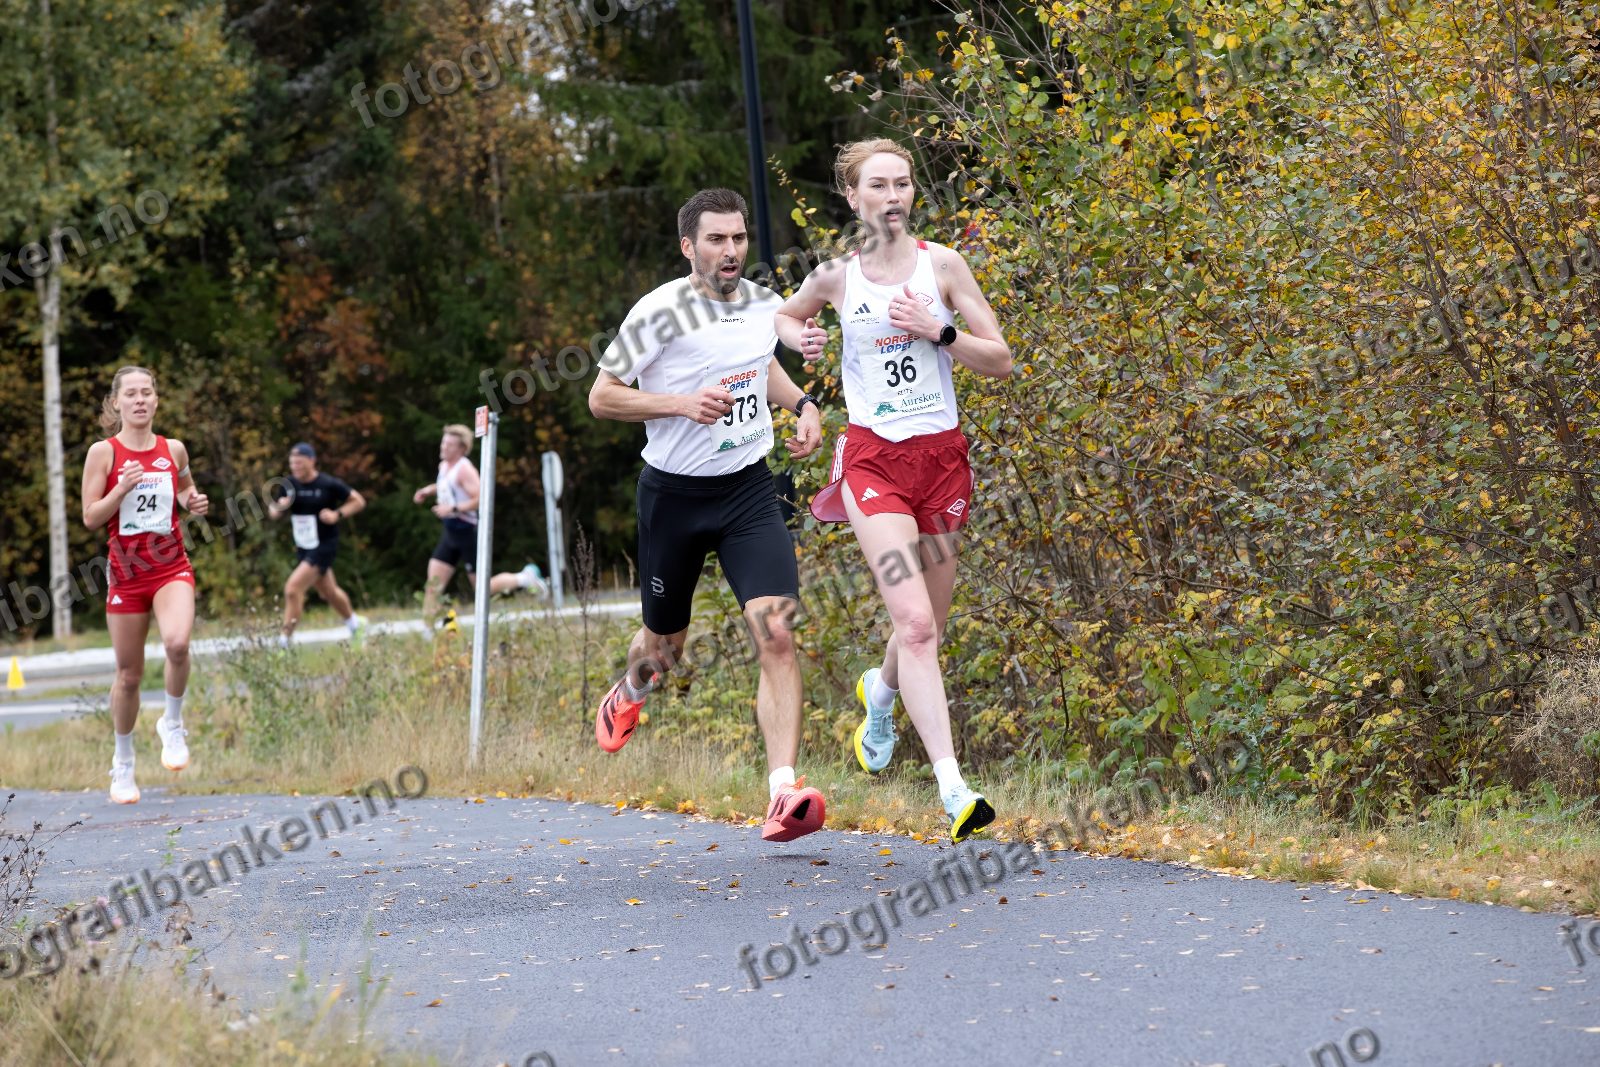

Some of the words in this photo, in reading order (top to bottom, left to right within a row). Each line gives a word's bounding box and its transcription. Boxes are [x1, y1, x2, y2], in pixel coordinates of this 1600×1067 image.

[880, 341, 915, 354] LØPET
[720, 369, 758, 386] NORGES
[884, 355, 917, 388] 36
[724, 379, 752, 392] ØPET
[900, 391, 942, 408] Aurskog
[136, 494, 157, 513] 24
